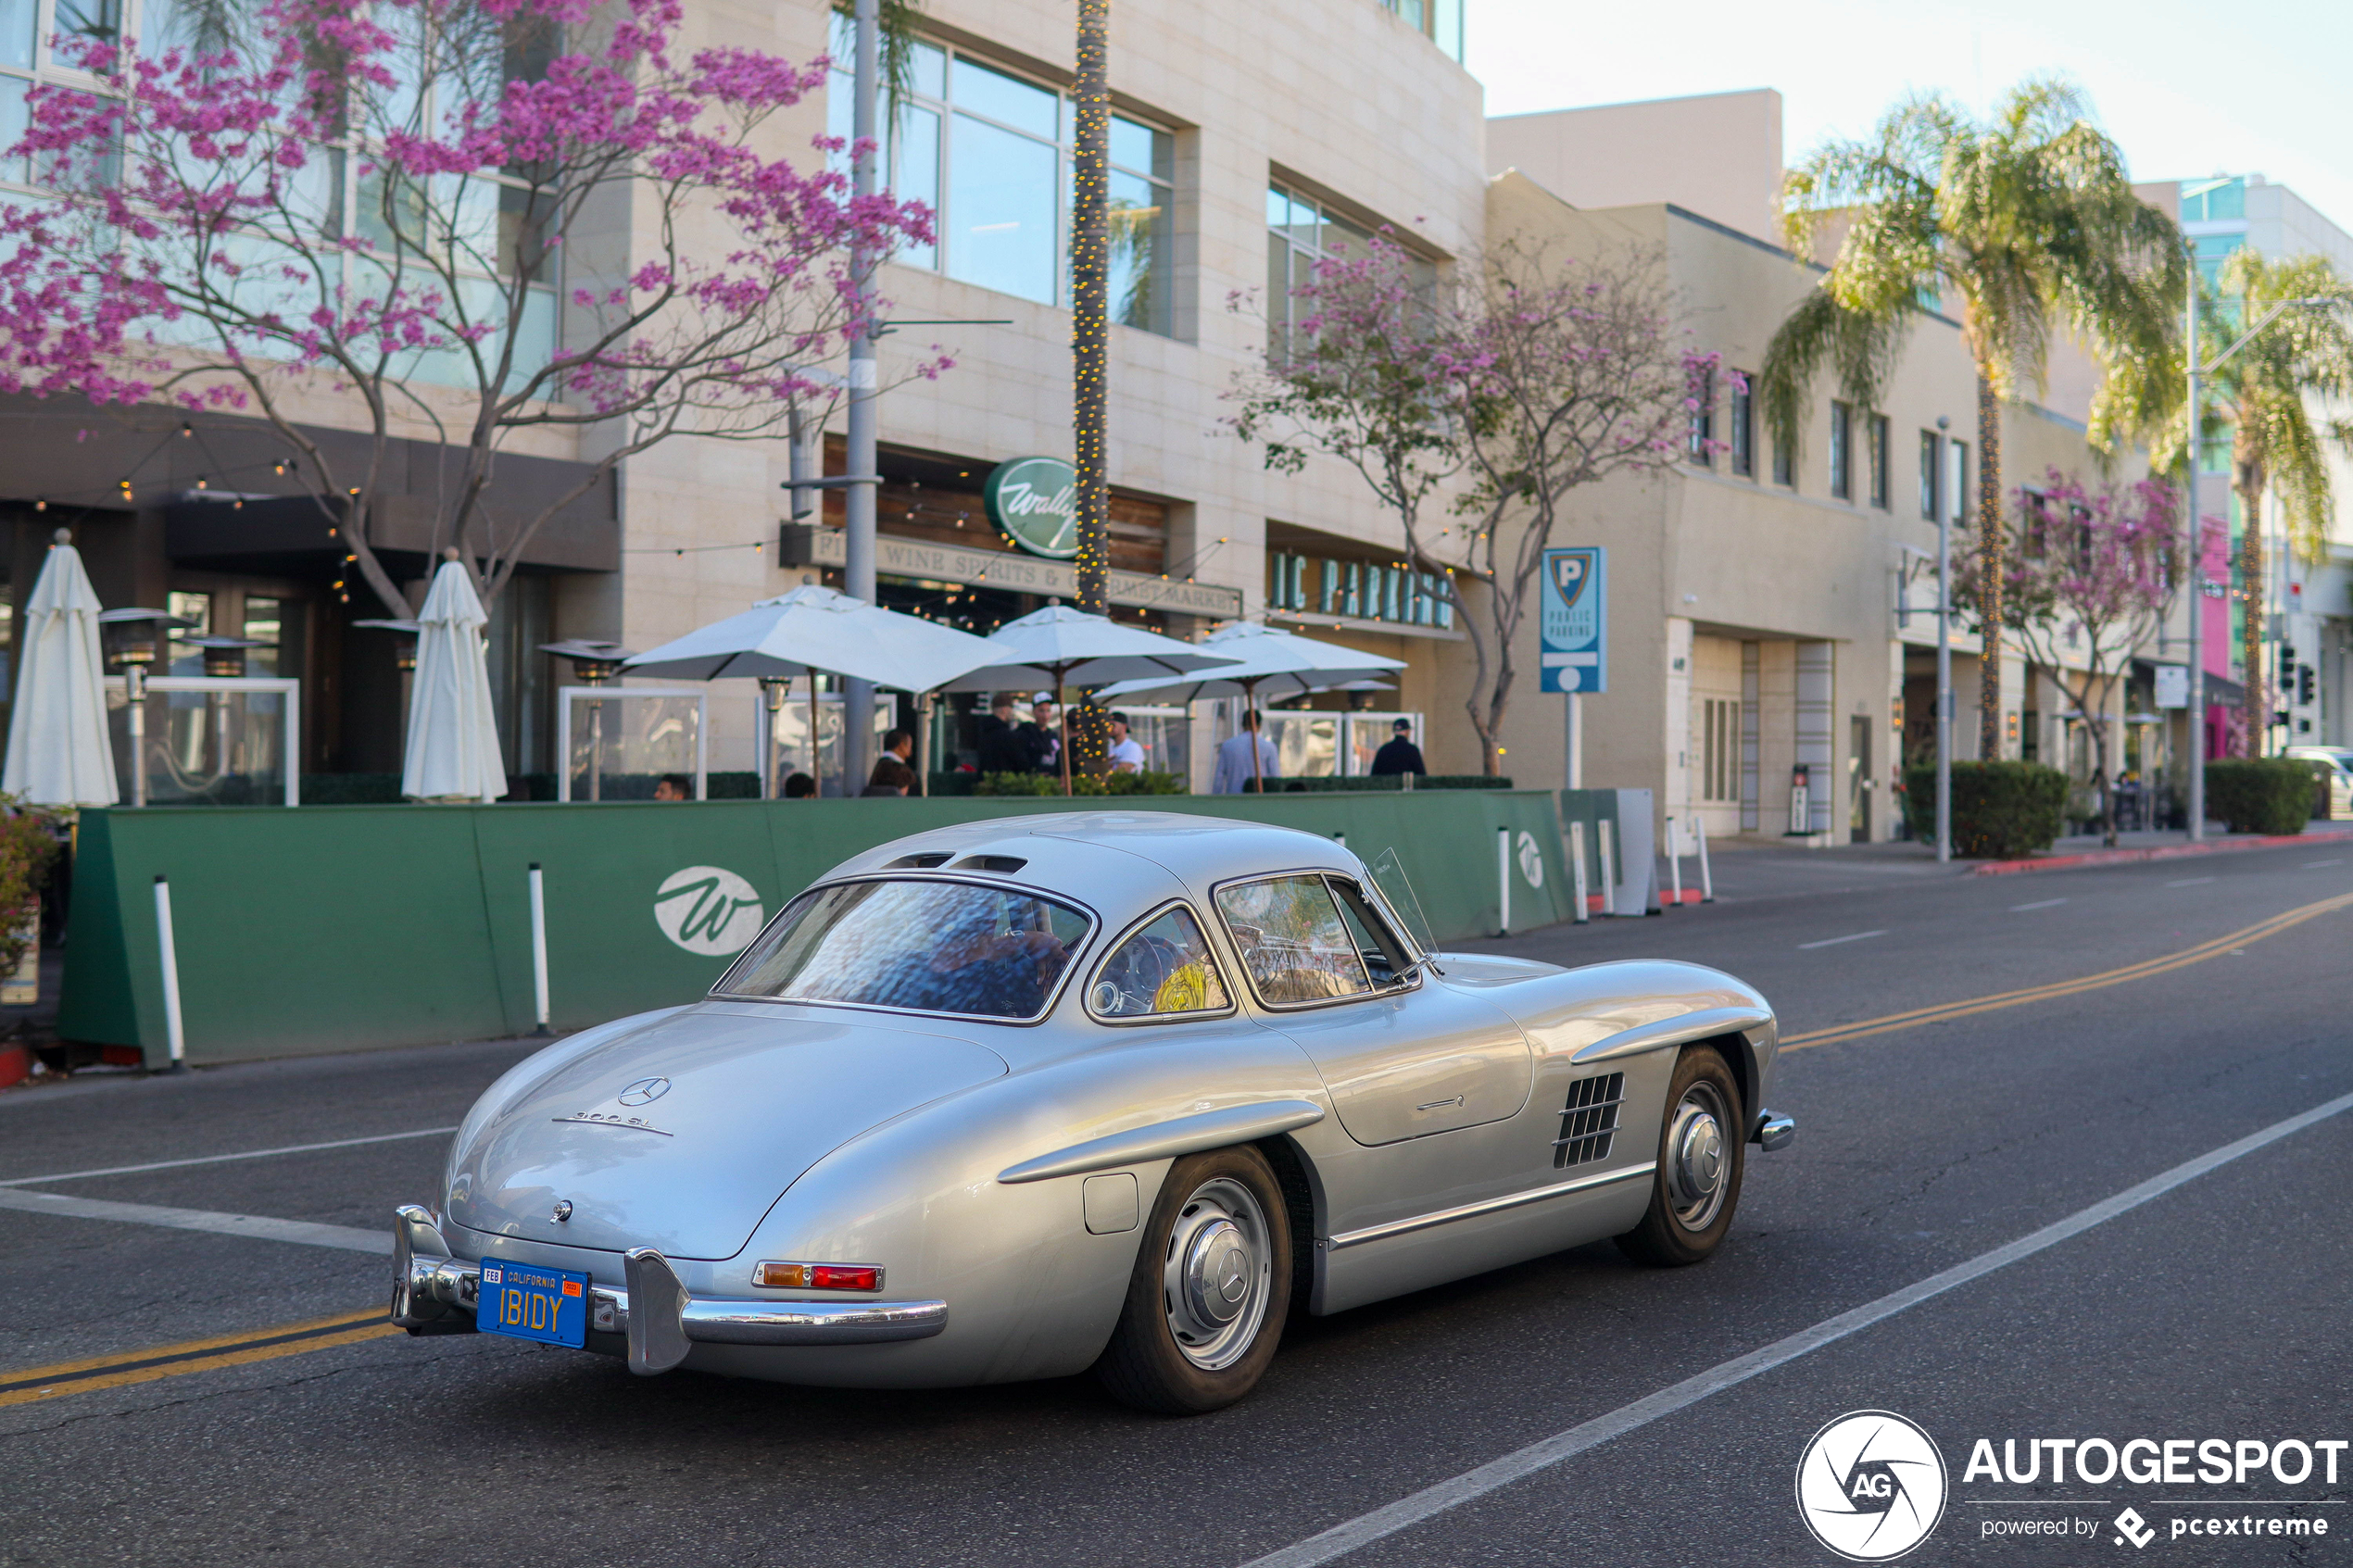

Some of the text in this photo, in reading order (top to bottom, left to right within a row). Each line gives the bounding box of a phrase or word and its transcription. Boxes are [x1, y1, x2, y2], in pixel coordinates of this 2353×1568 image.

[1000, 483, 1077, 548] Wally
[886, 546, 945, 571] WINE
[955, 558, 1036, 583] SPIRITS
[1045, 570, 1058, 586] &
[1167, 585, 1236, 610] MARKET
[1560, 559, 1582, 587] P
[573, 1110, 656, 1130] 300 SL
[485, 1270, 499, 1282] FEB
[508, 1272, 556, 1289] CALIFORNIA
[499, 1287, 563, 1333] IBIDY
